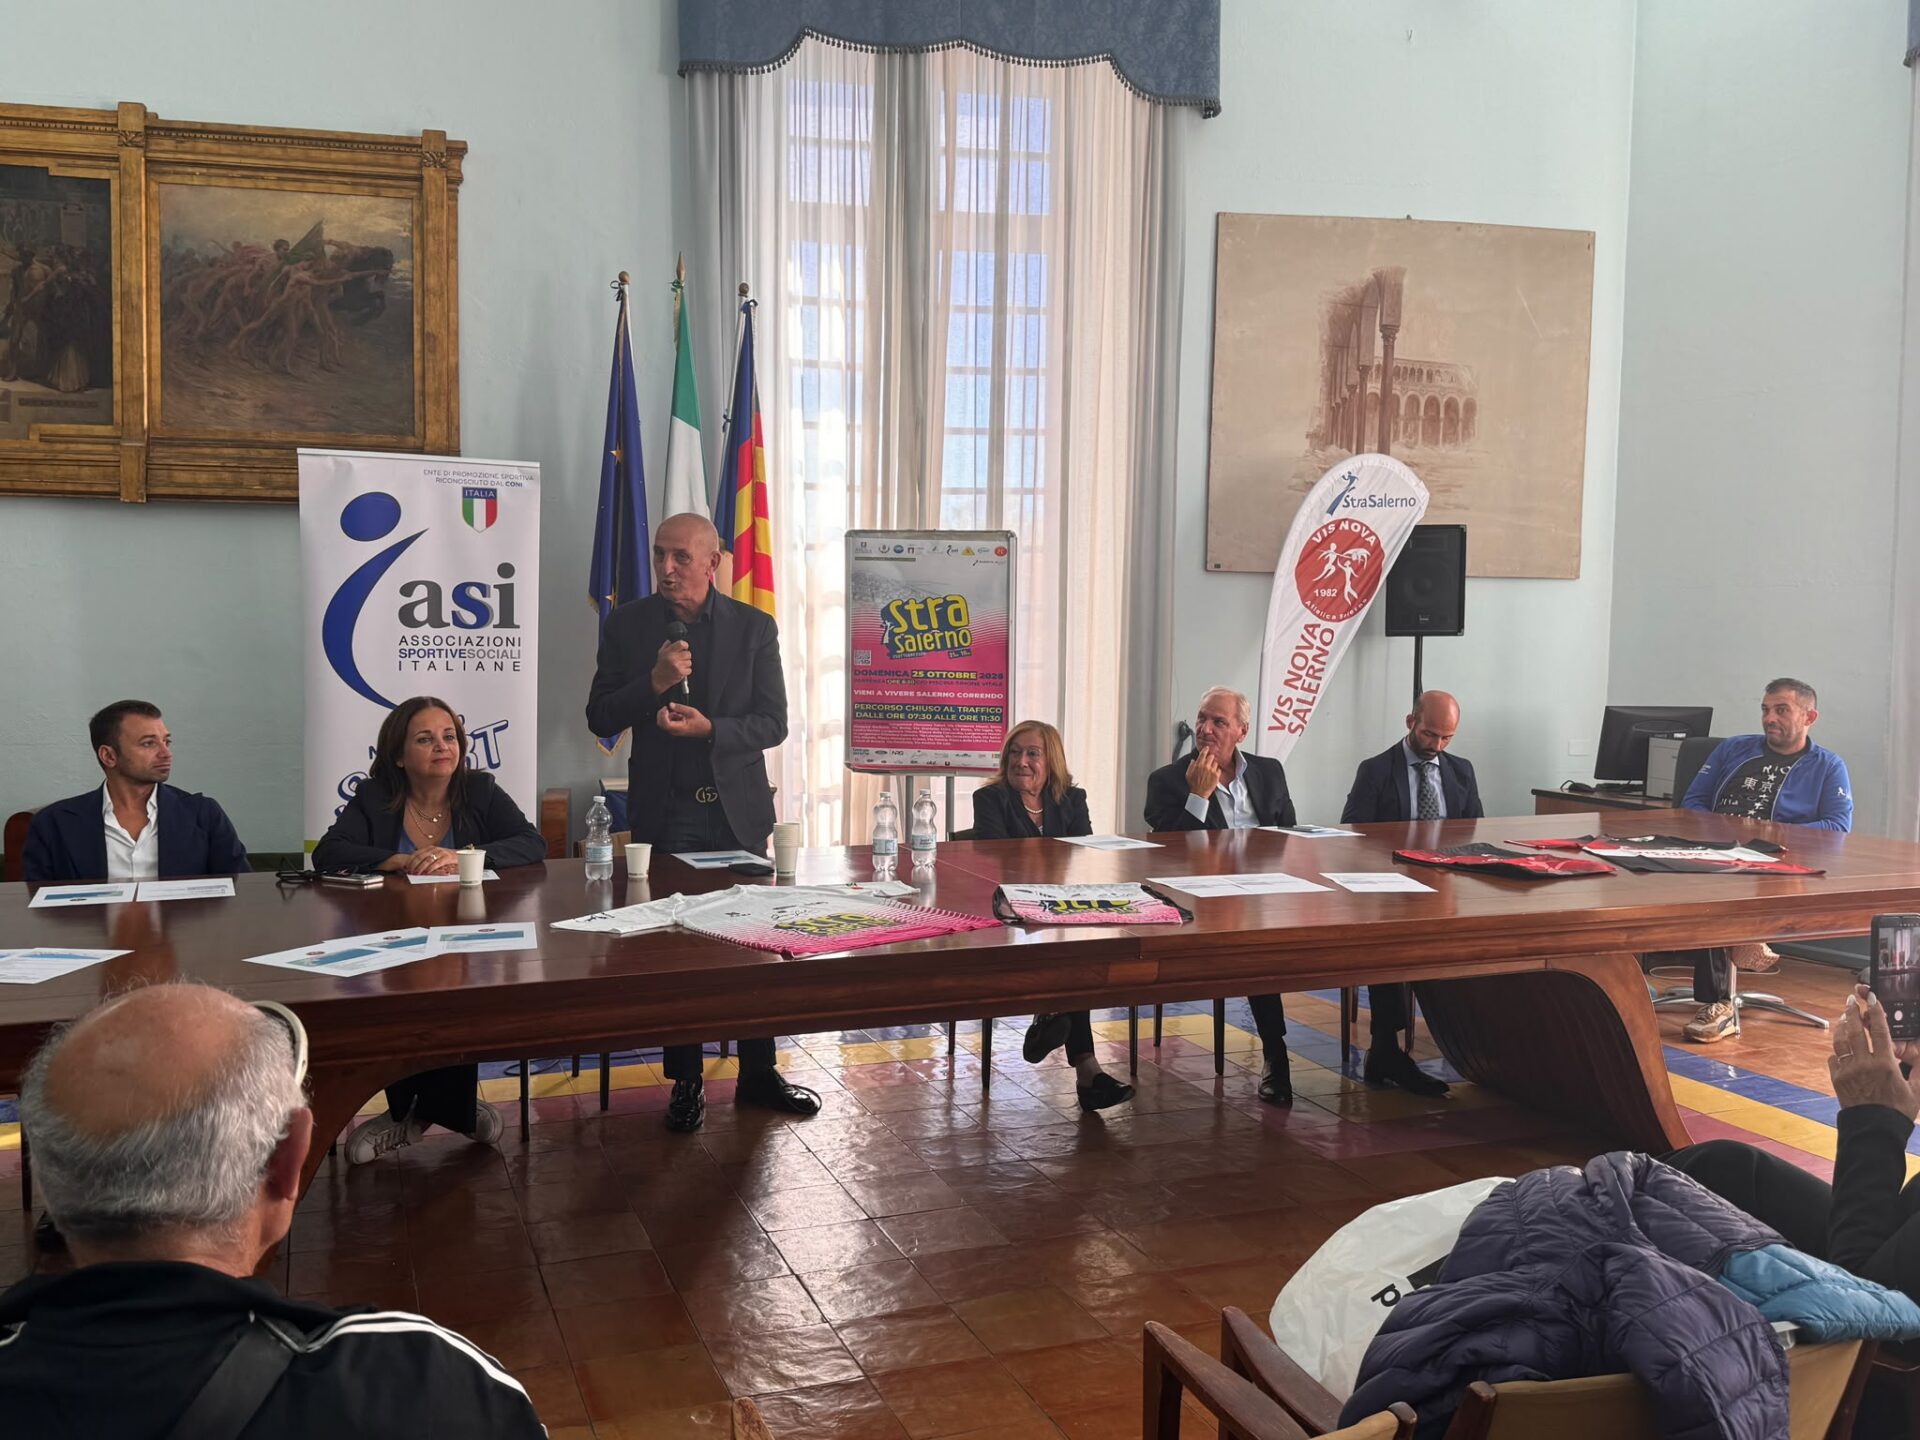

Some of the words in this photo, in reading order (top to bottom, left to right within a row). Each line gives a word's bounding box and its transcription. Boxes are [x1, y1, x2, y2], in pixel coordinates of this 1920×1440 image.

[452, 471, 499, 480] PROMOZIONE
[435, 477, 489, 486] RICONOSCIUTO
[465, 489, 496, 498] ITALIA
[1312, 523, 1336, 543] VIS
[1339, 520, 1377, 547] NOVA
[398, 561, 521, 629] asi
[1313, 588, 1338, 597] 1982
[398, 635, 521, 648] ASSOCIAZIONI
[398, 660, 521, 672] ITALIANE
[854, 669, 910, 677] DOMENICA
[911, 670, 924, 678] 25
[926, 671, 977, 679] OTTOBRE
[1267, 694, 1294, 731] VIS
[1283, 623, 1321, 691] NOVA
[1287, 627, 1335, 737] SALERNO
[854, 703, 904, 711] PERCORSO
[905, 704, 941, 712] CHIUSO
[957, 706, 1003, 714] TRAFFICO
[855, 711, 884, 719] DALLE
[886, 712, 906, 720] ORE
